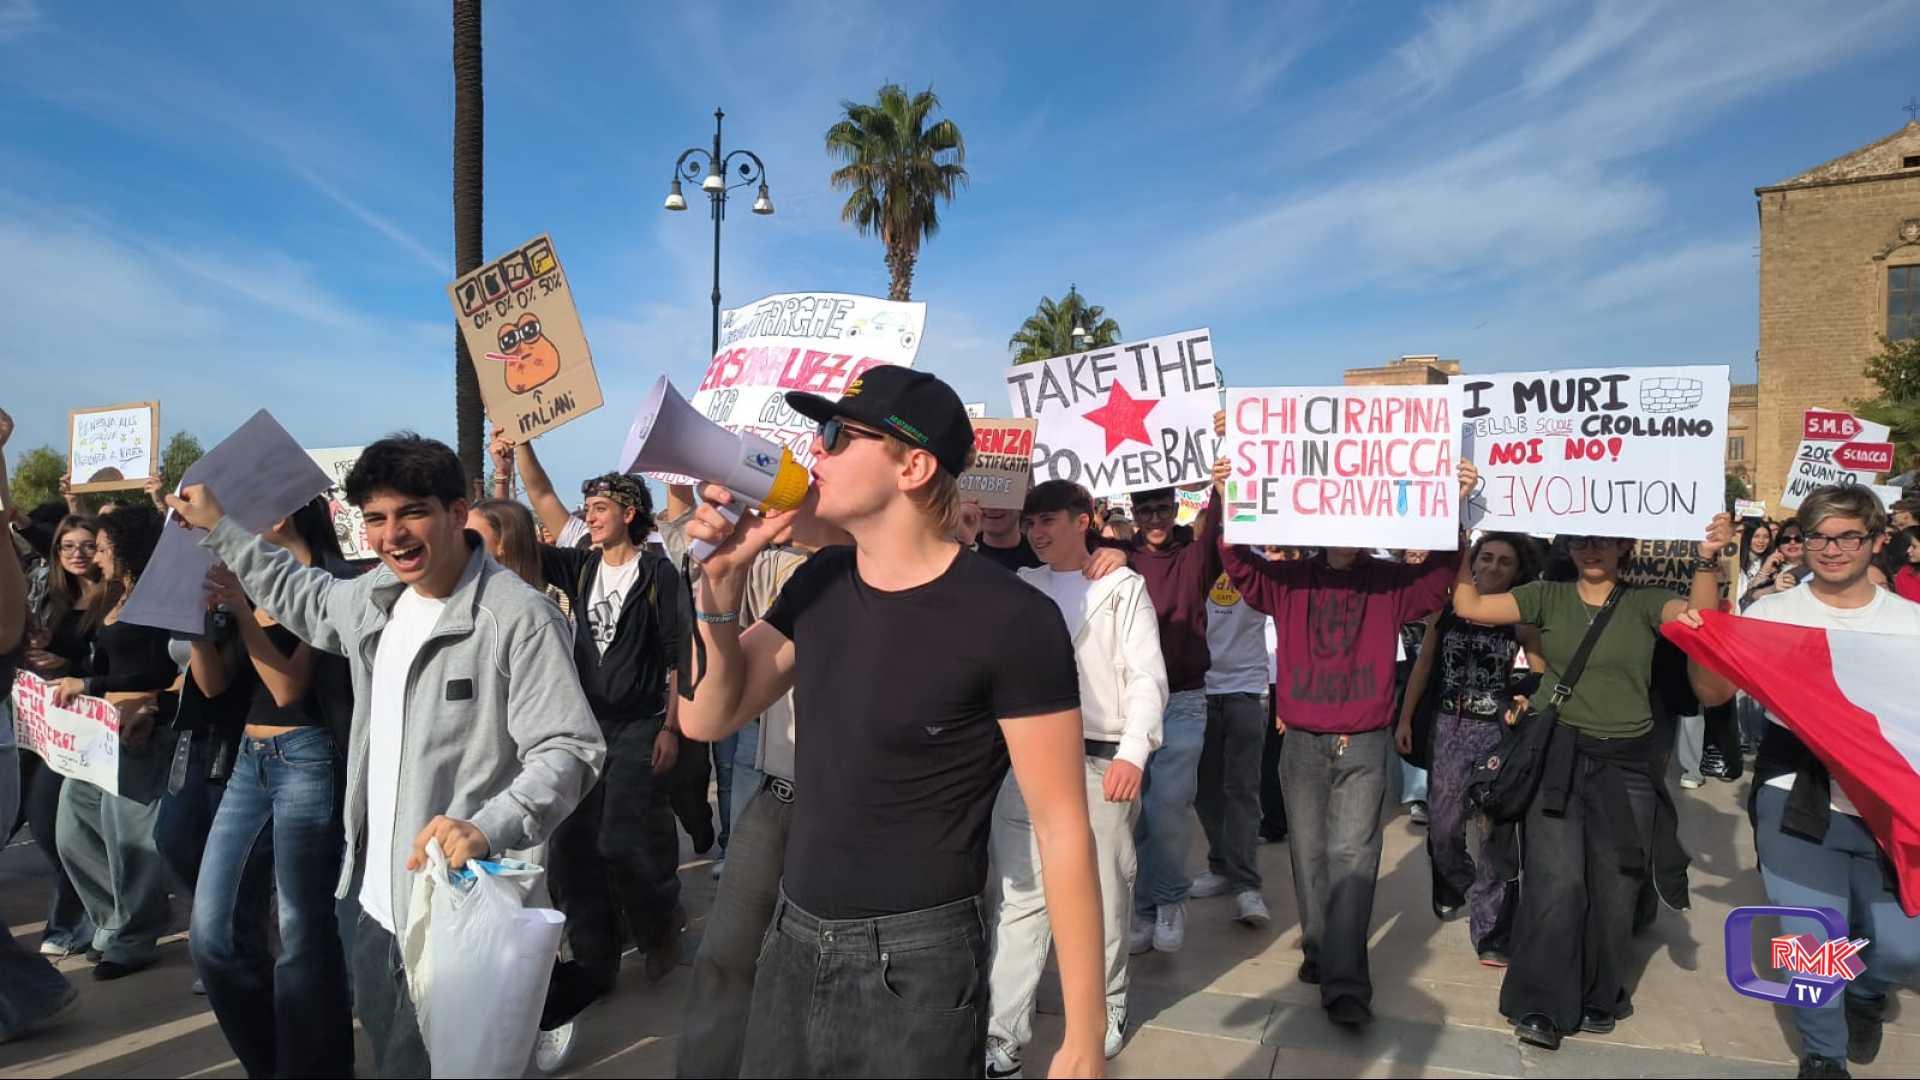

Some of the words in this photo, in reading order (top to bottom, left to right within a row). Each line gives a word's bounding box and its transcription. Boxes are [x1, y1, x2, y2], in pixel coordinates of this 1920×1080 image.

[474, 313, 492, 329] 0%
[495, 299, 513, 317] 0%
[517, 286, 536, 309] 0%
[748, 296, 855, 339] TARGHE
[1007, 352, 1118, 419] TAKE
[1124, 335, 1216, 398] THE
[1463, 381, 1494, 418] I
[1513, 374, 1630, 415] MURI
[1235, 396, 1297, 435] CHI
[1304, 395, 1339, 435] CI
[1344, 397, 1451, 435] RAPINA
[1581, 414, 1714, 438] CROLLANO
[1807, 416, 1855, 434] S.M.B
[976, 454, 1029, 473] STIFICATA
[1032, 442, 1163, 490] POWER
[1237, 439, 1296, 477] STA
[1302, 440, 1329, 477] IN
[1334, 438, 1452, 477] GIACCA
[1489, 438, 1543, 465] NOI
[1564, 437, 1623, 462] NO!
[1843, 447, 1888, 463] SCIACCA
[1788, 478, 1822, 497] AUM
[1800, 462, 1857, 486] QUANTO
[1262, 478, 1279, 515] E
[1292, 478, 1449, 518] CRAVATTA
